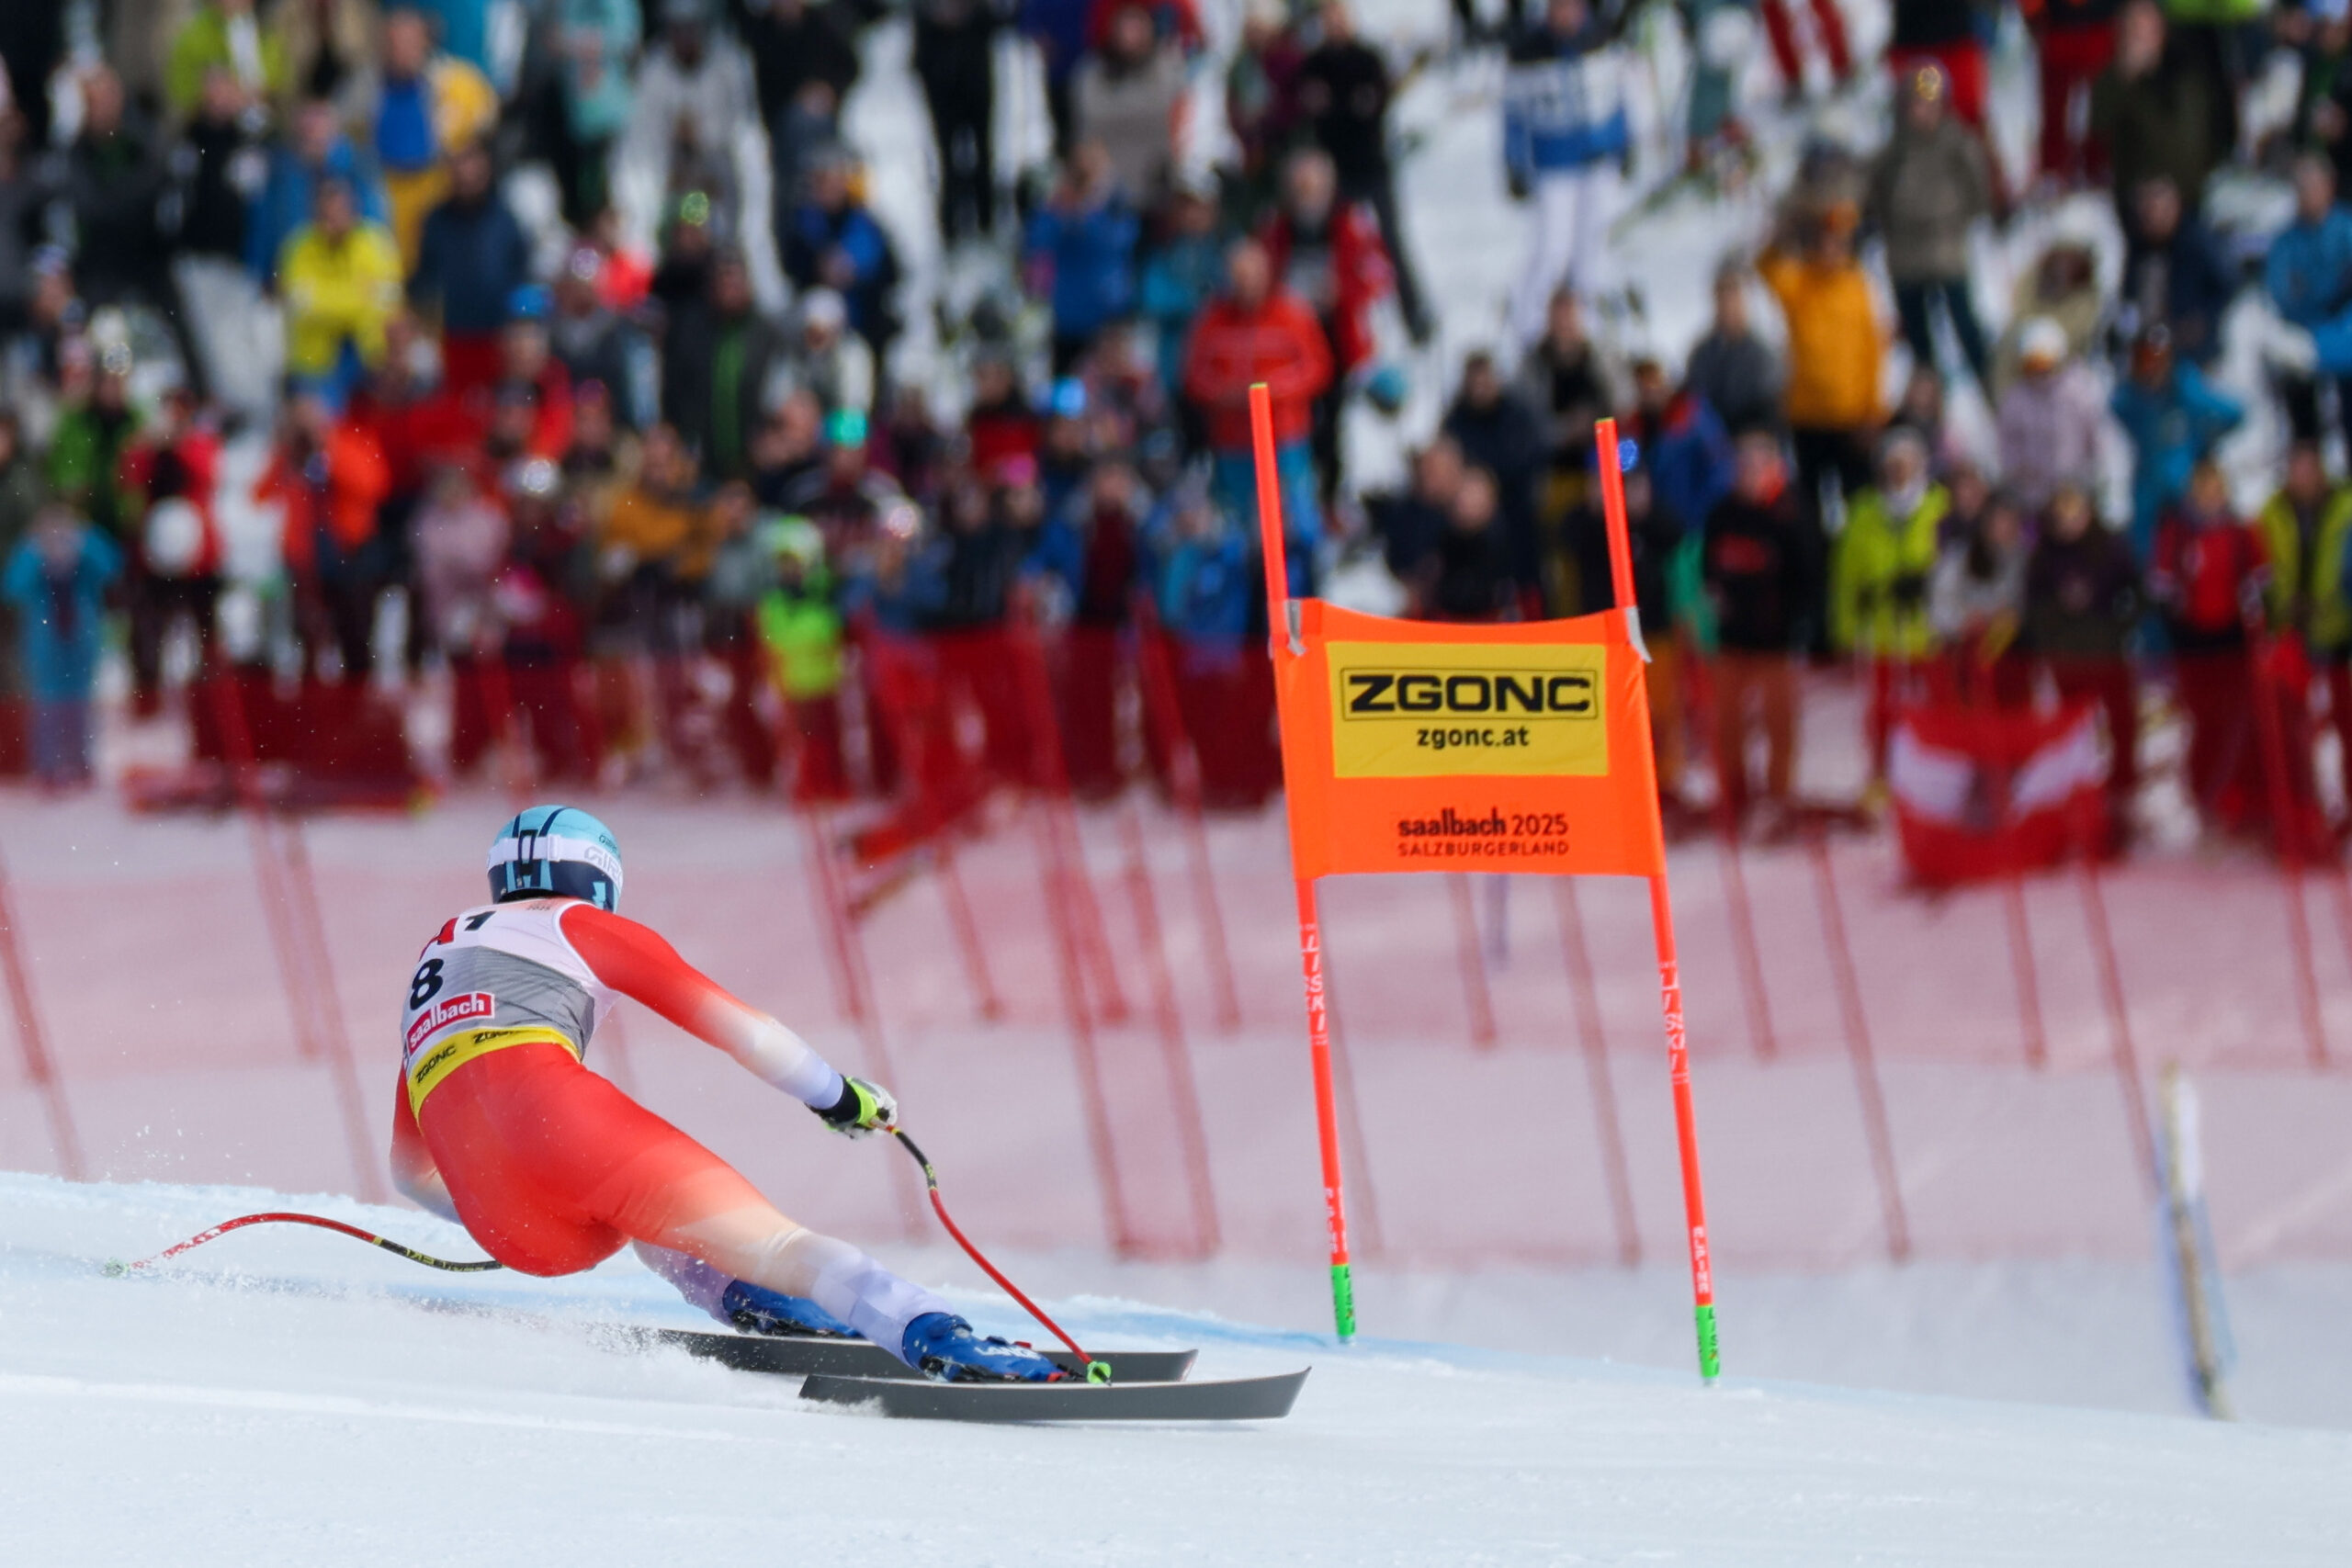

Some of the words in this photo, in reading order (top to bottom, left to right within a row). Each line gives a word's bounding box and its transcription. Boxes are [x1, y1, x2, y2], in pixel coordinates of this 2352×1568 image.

[1348, 674, 1591, 713] ZGONC
[1417, 727, 1530, 750] zgonc.at
[1398, 808, 1507, 836] saalbach
[1512, 814, 1568, 836] 2025
[1398, 842, 1569, 858] SALZBURGERLAND
[410, 992, 485, 1049] saalbach
[416, 1043, 457, 1084] ZGONC
